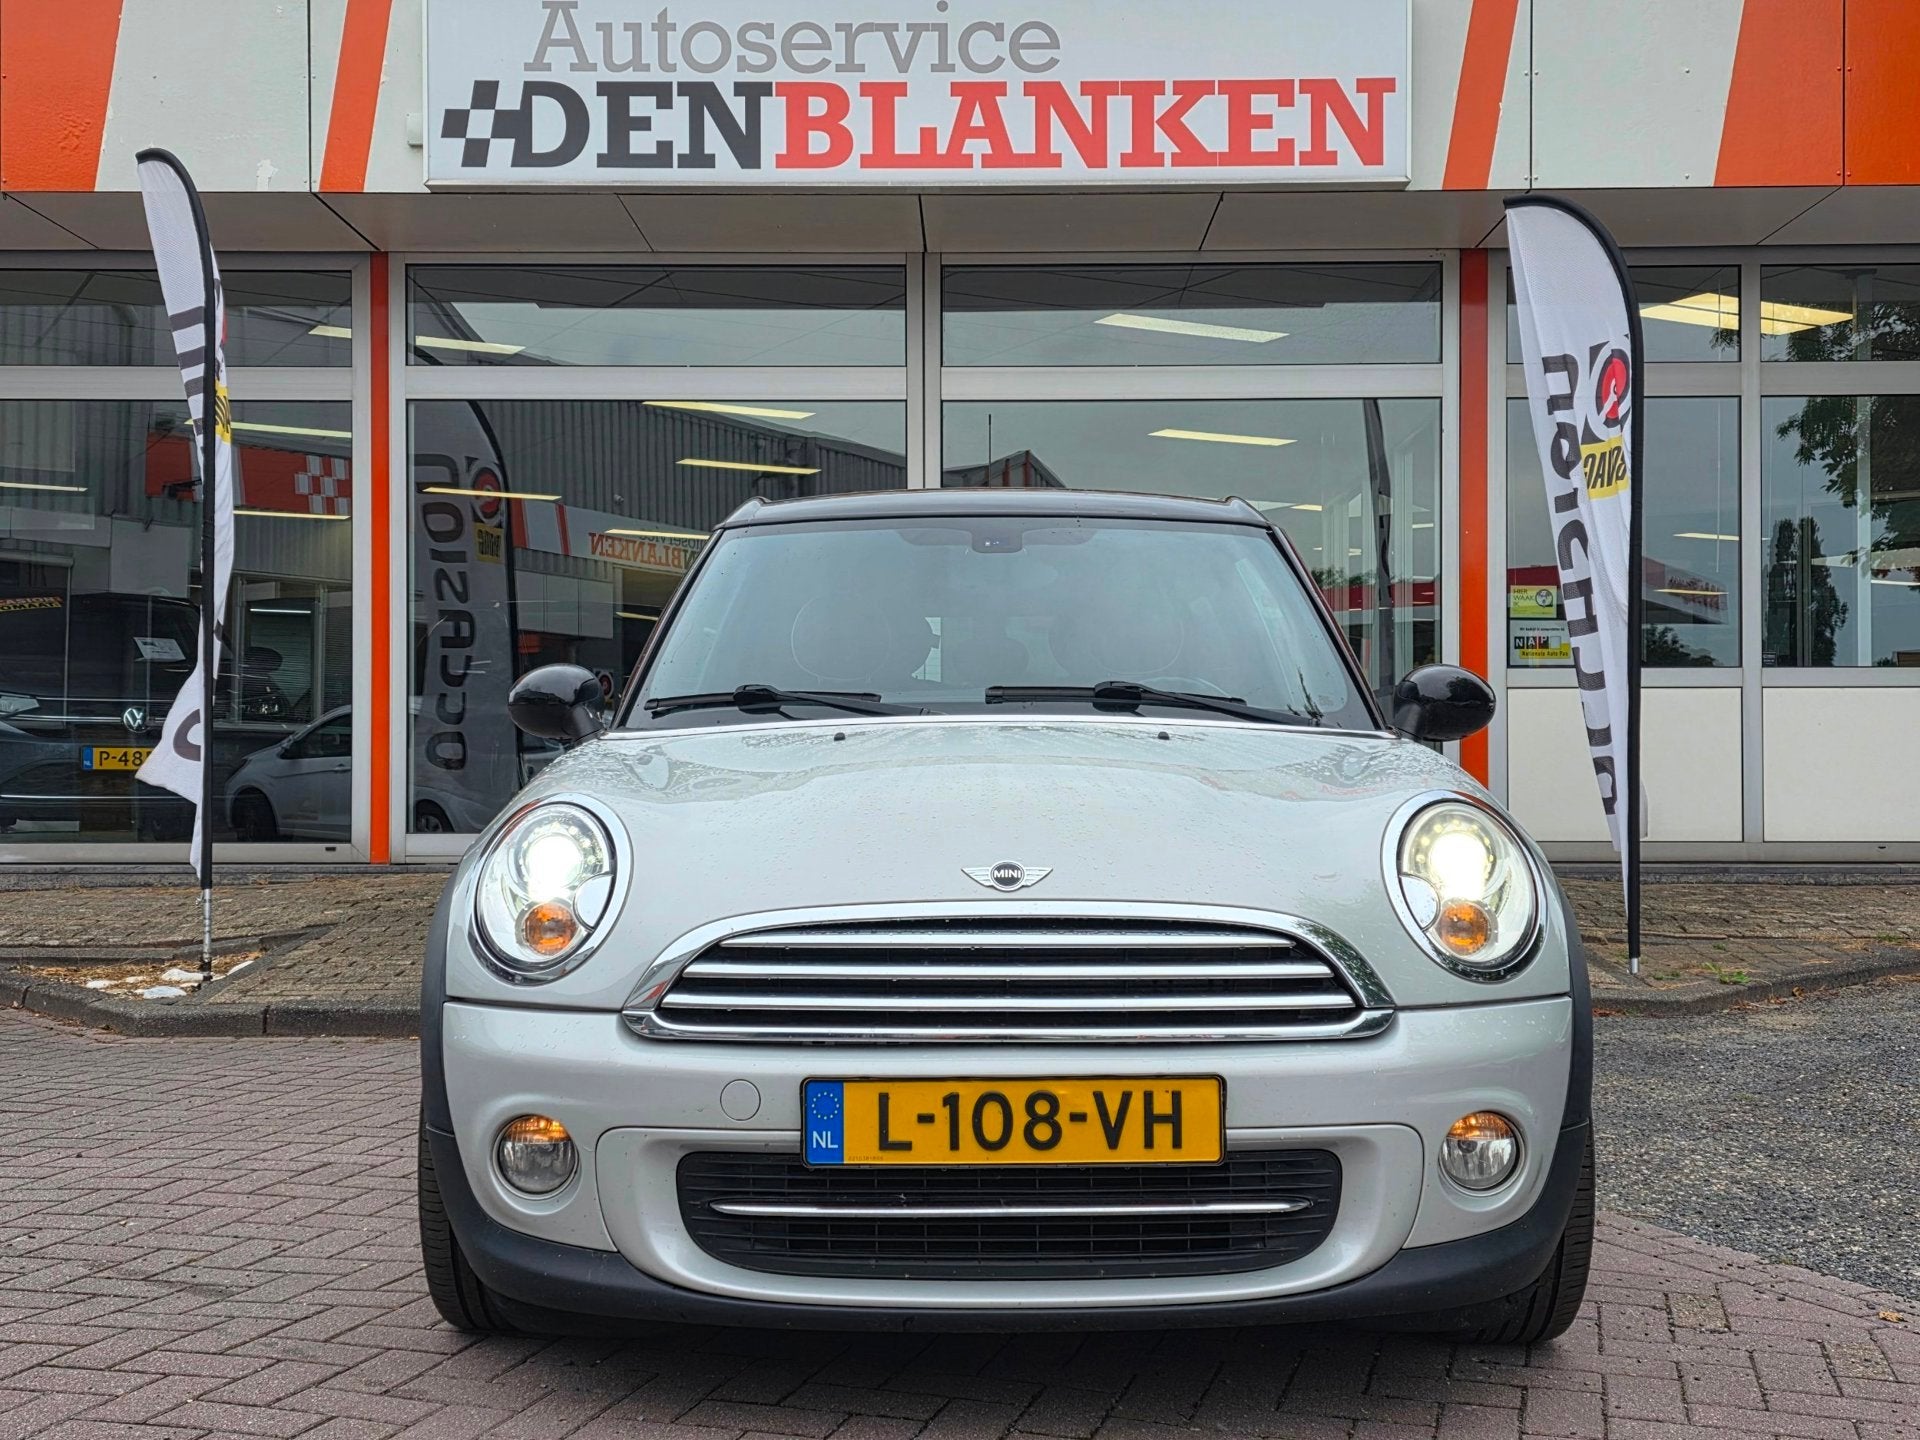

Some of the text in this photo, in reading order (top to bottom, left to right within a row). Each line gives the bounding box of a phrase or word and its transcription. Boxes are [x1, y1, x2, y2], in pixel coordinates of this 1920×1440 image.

[523, 0, 1061, 73] Autoservice
[1516, 635, 1548, 648] NAP
[993, 869, 1022, 879] MINI
[878, 1091, 1183, 1152] L-108-VH
[812, 1130, 839, 1149] NL
